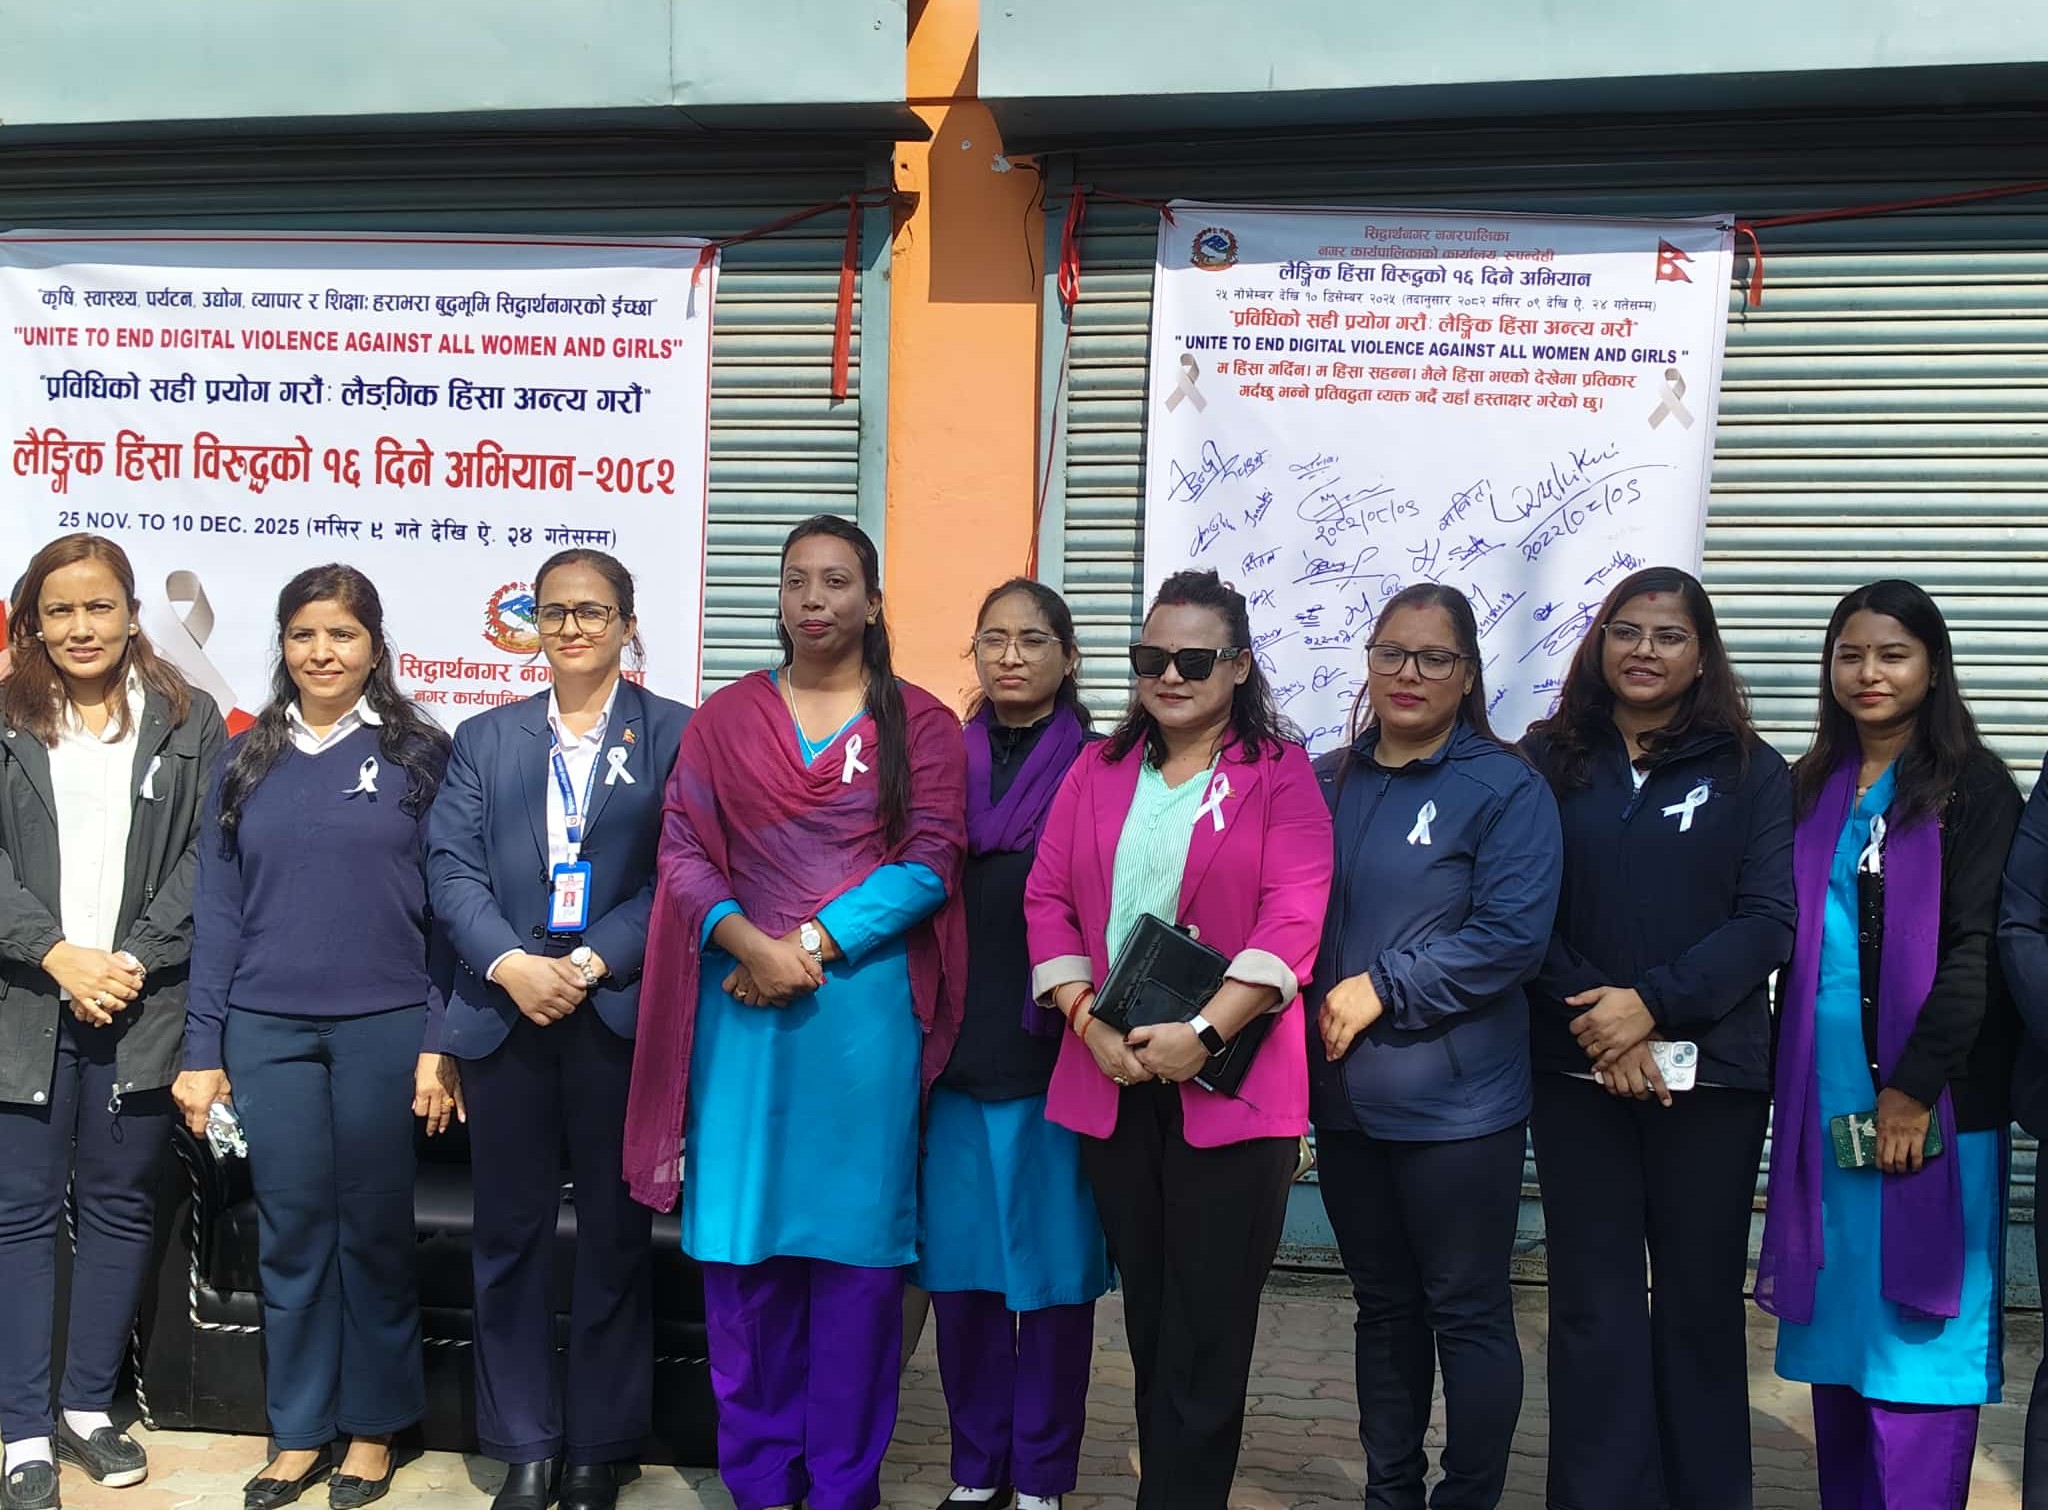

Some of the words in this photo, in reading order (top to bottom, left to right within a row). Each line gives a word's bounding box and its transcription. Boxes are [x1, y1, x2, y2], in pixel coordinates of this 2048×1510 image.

[1337, 262, 1375, 281] हिंसा
[1453, 270, 1474, 286] १६
[1481, 266, 1514, 286] दिने
[1520, 267, 1592, 287] अभियान
[251, 292, 304, 310] व्यापार
[308, 294, 320, 310] र
[373, 295, 431, 312] हराभरा
[1306, 310, 1340, 330] सही
[1345, 311, 1391, 330] प्रयोग
[1499, 314, 1539, 335] हिंसा
[1544, 321, 1595, 336] अन्त्य
[14, 326, 78, 346] "UNITE
[85, 327, 110, 347] TO
[116, 328, 154, 348] END
[160, 329, 235, 349] DIGITAL
[241, 329, 338, 351] VIOLENCE
[344, 332, 432, 353] AGAINST
[438, 334, 475, 354] ALL
[481, 334, 557, 356] WOMEN
[563, 336, 606, 357] AND
[612, 337, 683, 359] GIRLS"
[1185, 335, 1228, 350] UNITE
[1232, 336, 1251, 350] TO
[1255, 337, 1284, 351] END
[1289, 337, 1346, 353] DIGITAL
[1351, 340, 1424, 356] VIOLENCE
[1428, 342, 1496, 358] AGAINST
[1499, 344, 1527, 359] ALL
[1532, 345, 1590, 361] WOMEN
[1594, 347, 1626, 362] AND
[1631, 349, 1677, 364] GIRLS
[1233, 359, 1264, 376] हिंसा
[1333, 361, 1364, 379] हिंसा
[1421, 364, 1448, 381] मैले
[1452, 366, 1485, 383] हिंसा
[1489, 368, 1530, 383] भएको
[1534, 368, 1578, 385] देखेमा
[1582, 370, 1637, 388] प्रतिकार
[149, 372, 197, 403] सही
[204, 373, 271, 405] प्रयोग
[448, 377, 506, 411] हिंसा
[513, 387, 588, 412] अन्त्य
[1278, 383, 1310, 398] भन्ने
[1537, 391, 1579, 408] गरेको
[13, 427, 106, 494] लैङ्गिक
[115, 429, 183, 481] हिंसा
[323, 448, 360, 489] १६
[374, 436, 435, 489] दिने
[58, 511, 80, 527] 25
[87, 512, 131, 529] NOV.
[138, 513, 165, 530] TO
[172, 515, 193, 531] 10
[200, 515, 247, 533] DEC.
[254, 518, 299, 535] 2025
[394, 518, 423, 540] गते
[430, 518, 468, 542] देखि
[508, 527, 532, 547] २४
[544, 524, 616, 549] गतेसम्म)
